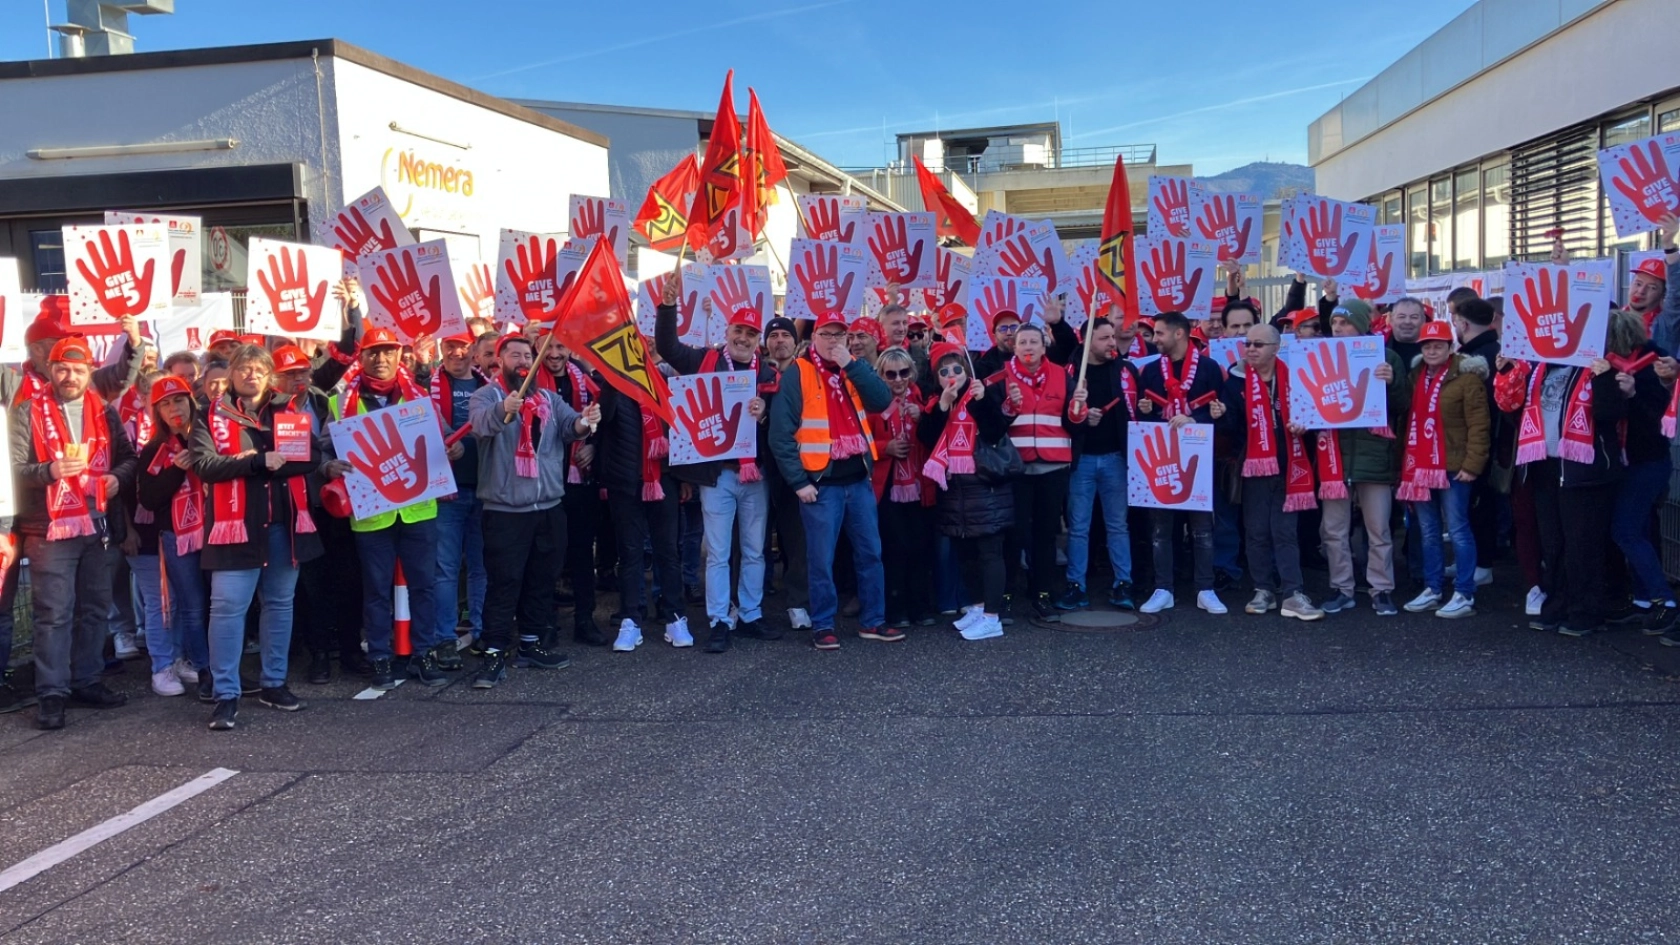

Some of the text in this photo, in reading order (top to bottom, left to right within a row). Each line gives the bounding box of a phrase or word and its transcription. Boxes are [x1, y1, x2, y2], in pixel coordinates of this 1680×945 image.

[398, 150, 473, 197] Nemera
[1642, 176, 1670, 198] GIVE
[1643, 186, 1679, 211] ME 5
[1170, 206, 1188, 216] GIVE
[1179, 214, 1189, 230] 5
[1215, 226, 1235, 238] GIVE
[717, 229, 730, 250] 5
[1225, 234, 1239, 253] 5
[1315, 238, 1337, 247] GIVE
[885, 248, 907, 261] GIVE
[1313, 248, 1339, 268] ME 5
[885, 257, 910, 277] ME 5
[105, 270, 134, 288] GIVE
[527, 278, 553, 291] GIVE
[813, 278, 835, 291] GIVE
[1160, 275, 1183, 286] GIVE
[1367, 270, 1381, 292] 5
[104, 280, 140, 308] ME 5
[280, 287, 306, 301] GIVE
[398, 290, 423, 308] GIVE
[525, 289, 555, 313] ME 5
[811, 288, 837, 309] ME 5
[935, 288, 945, 307] 5
[1158, 284, 1185, 306] ME 5
[278, 298, 311, 322] ME 5
[399, 307, 414, 321] ME
[412, 301, 431, 326] 5
[1537, 312, 1565, 326] GIVE
[1534, 323, 1568, 349] ME 5
[1322, 378, 1349, 394] GIVE
[1321, 389, 1353, 414] ME 5
[698, 413, 722, 430] GIVE
[697, 428, 712, 441] ME
[710, 423, 727, 447] 5
[379, 452, 407, 474] GIVE
[1156, 463, 1179, 476] GIVE
[380, 470, 399, 487] ME
[395, 462, 417, 489] 5
[1155, 473, 1183, 496] ME 5
